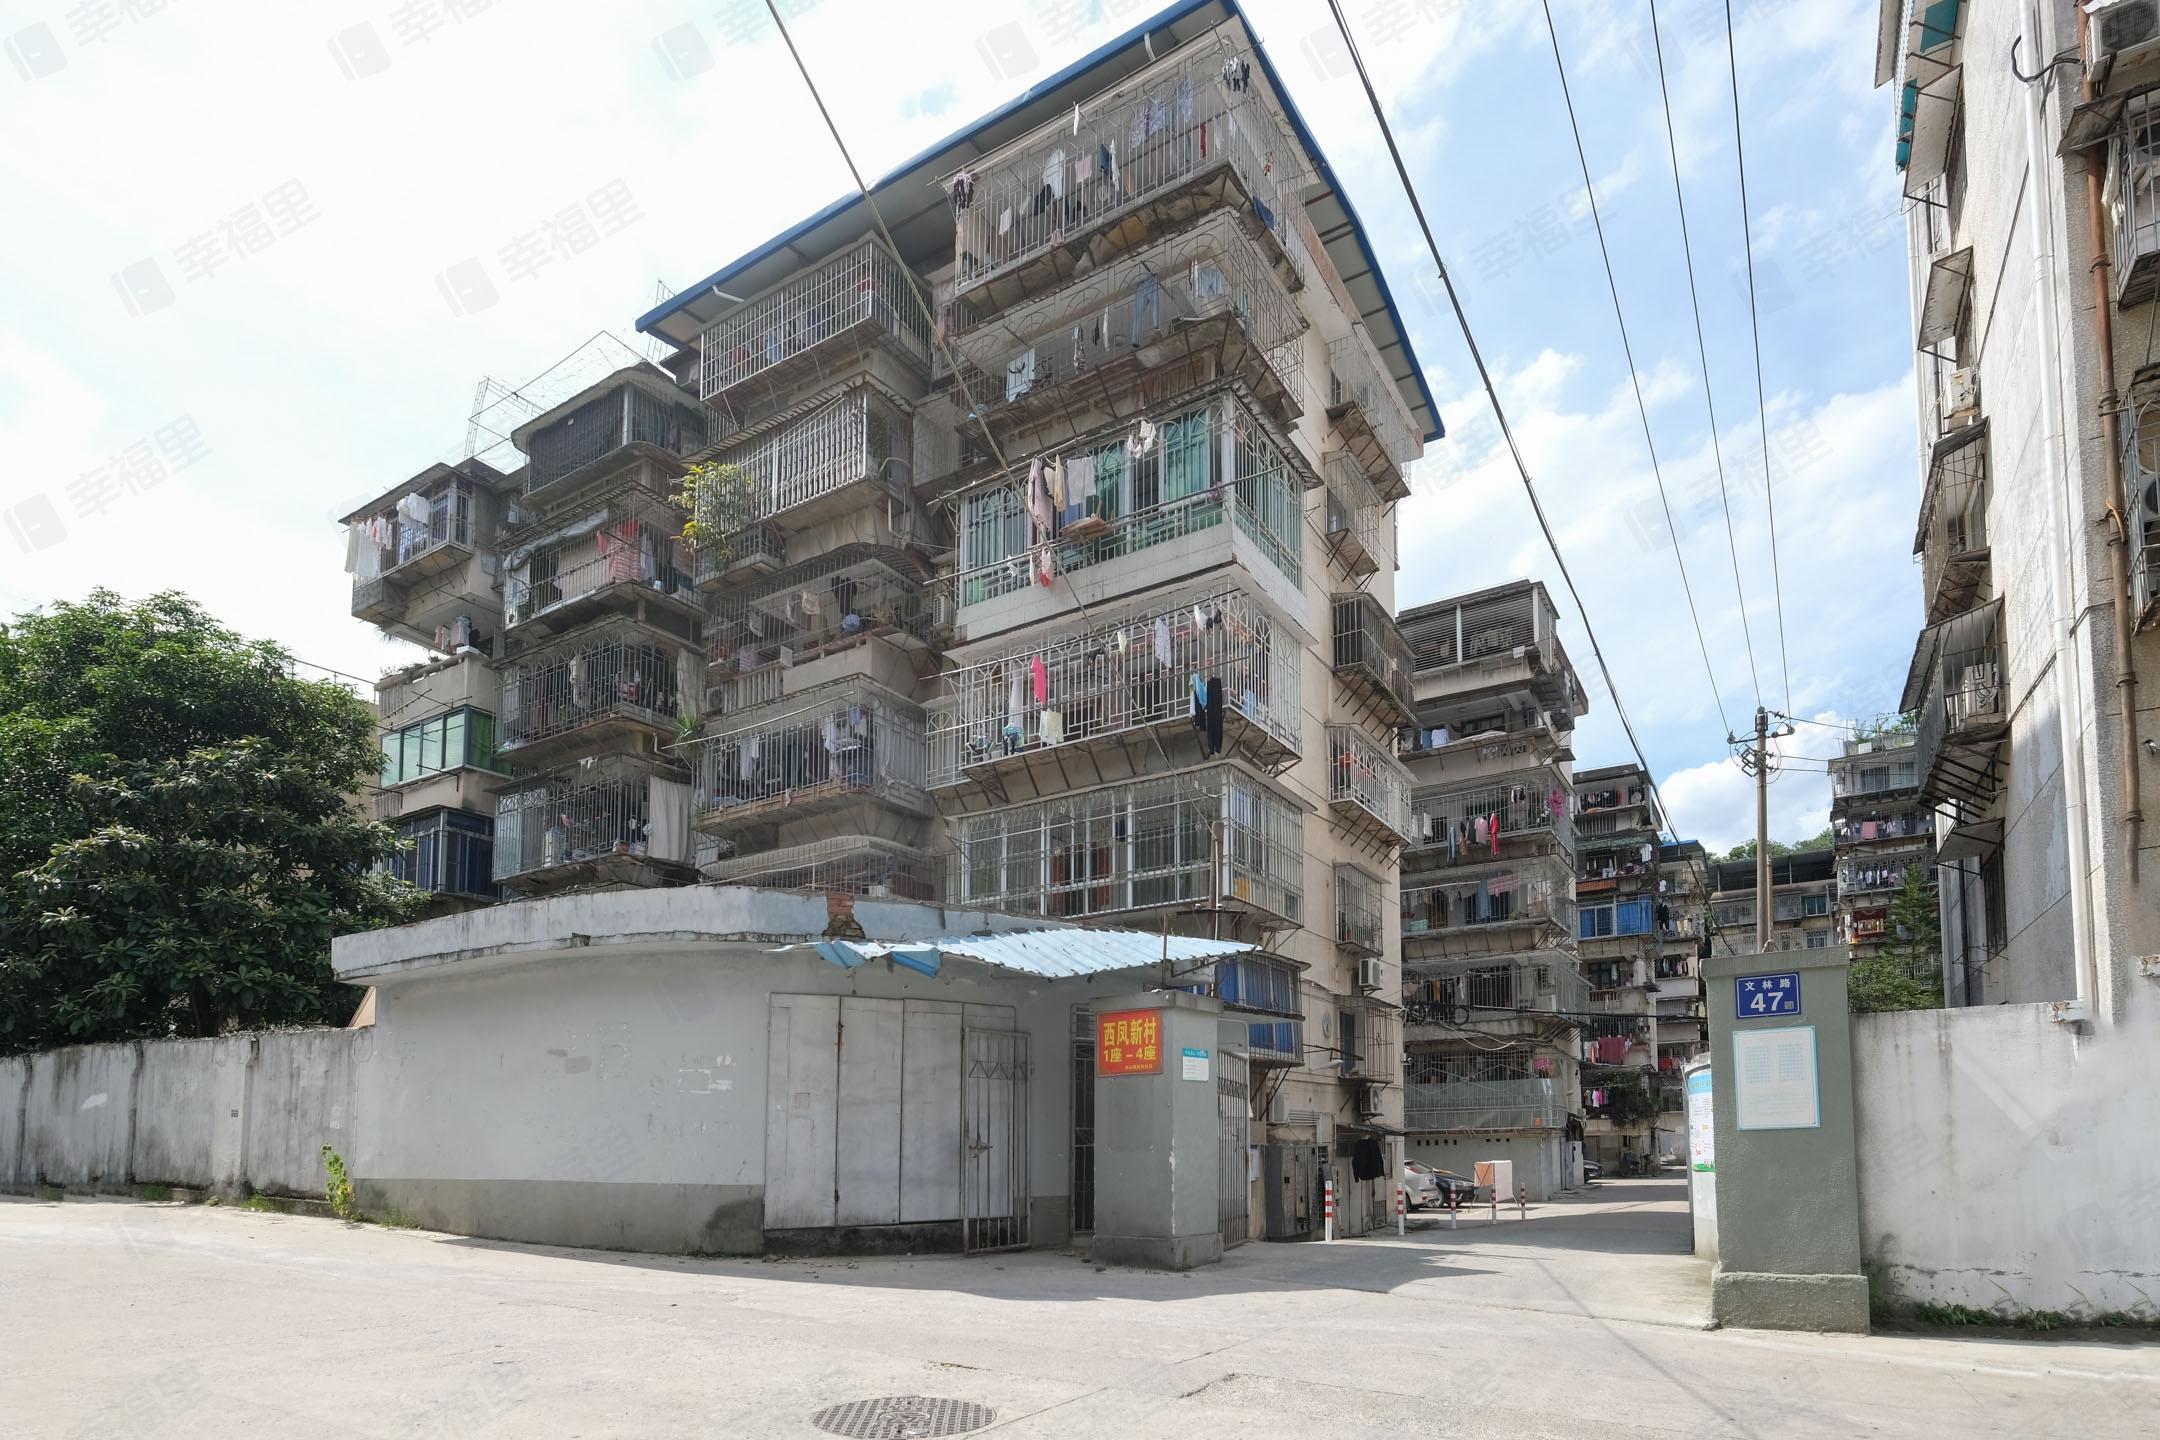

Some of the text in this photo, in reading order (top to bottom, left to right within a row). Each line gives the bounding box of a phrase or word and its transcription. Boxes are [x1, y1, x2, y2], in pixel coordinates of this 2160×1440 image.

[1745, 978, 1791, 991] 文林路
[1750, 991, 1784, 1013] 47
[1103, 1016, 1157, 1046] 西凤新村
